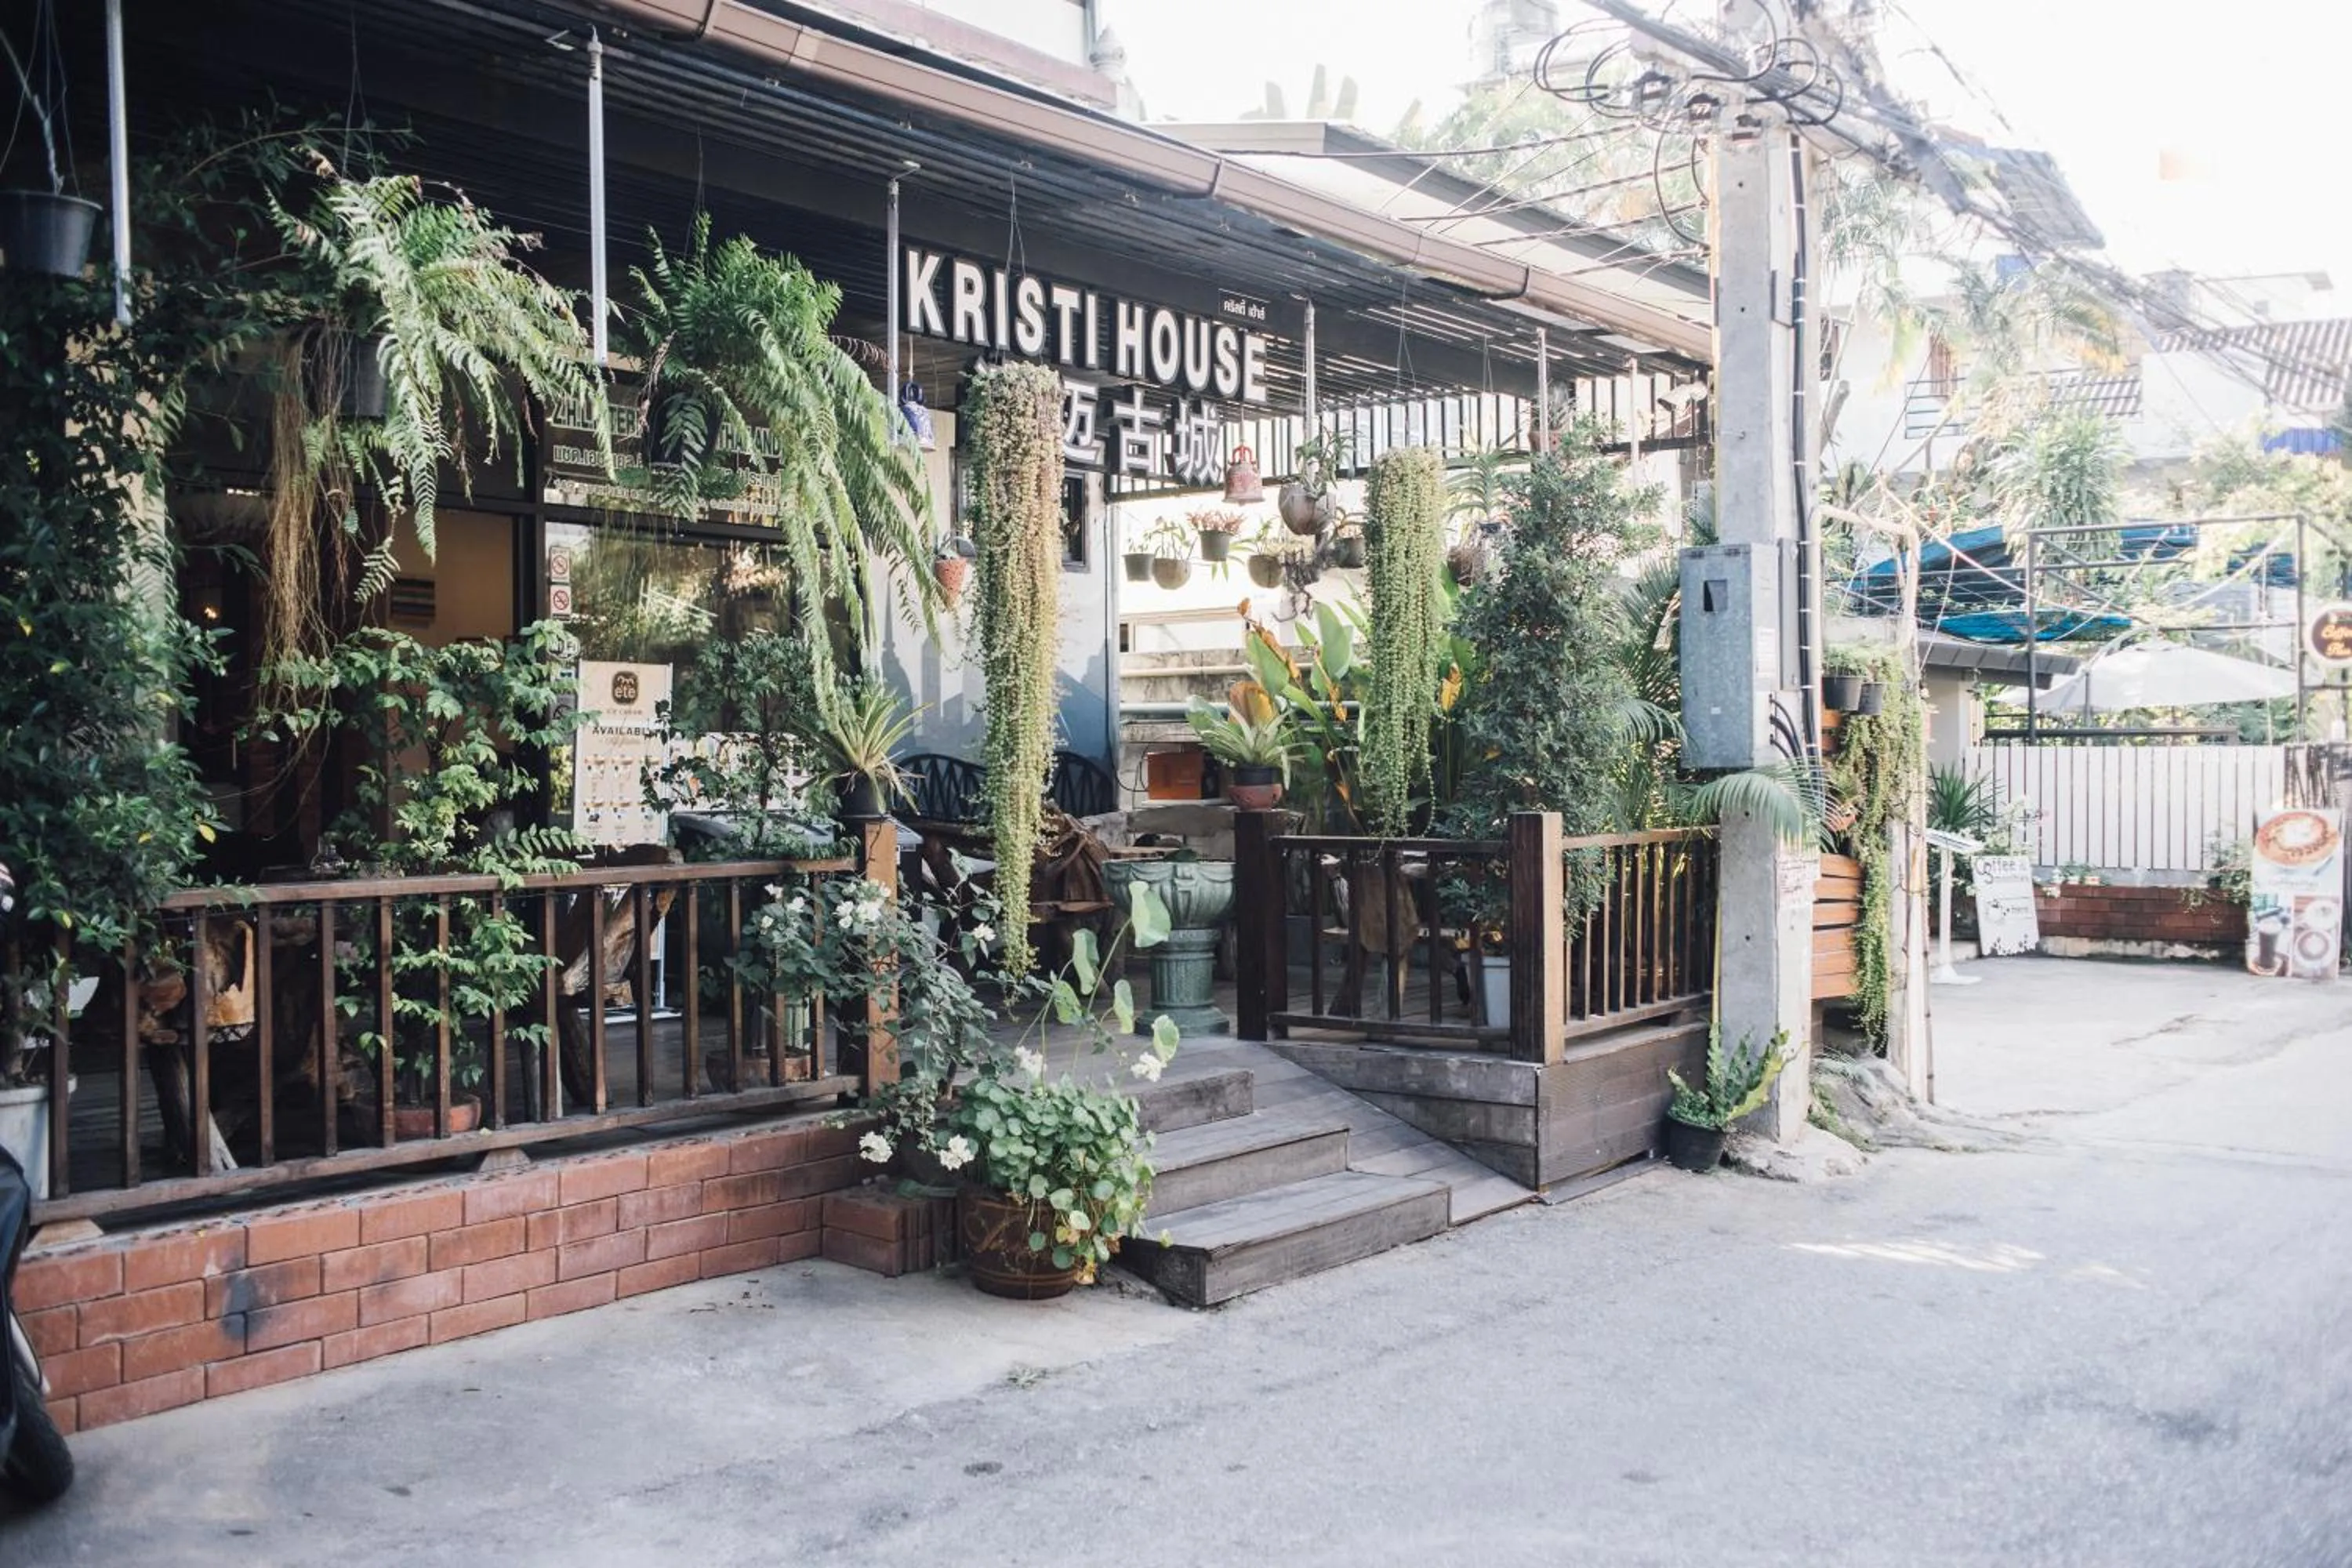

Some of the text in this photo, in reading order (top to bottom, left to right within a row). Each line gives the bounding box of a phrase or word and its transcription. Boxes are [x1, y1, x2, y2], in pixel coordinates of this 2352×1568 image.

[906, 247, 1268, 404] KRISTI HOUSE
[1062, 378, 1221, 491] 迈古城
[592, 727, 655, 738] AVAILABL
